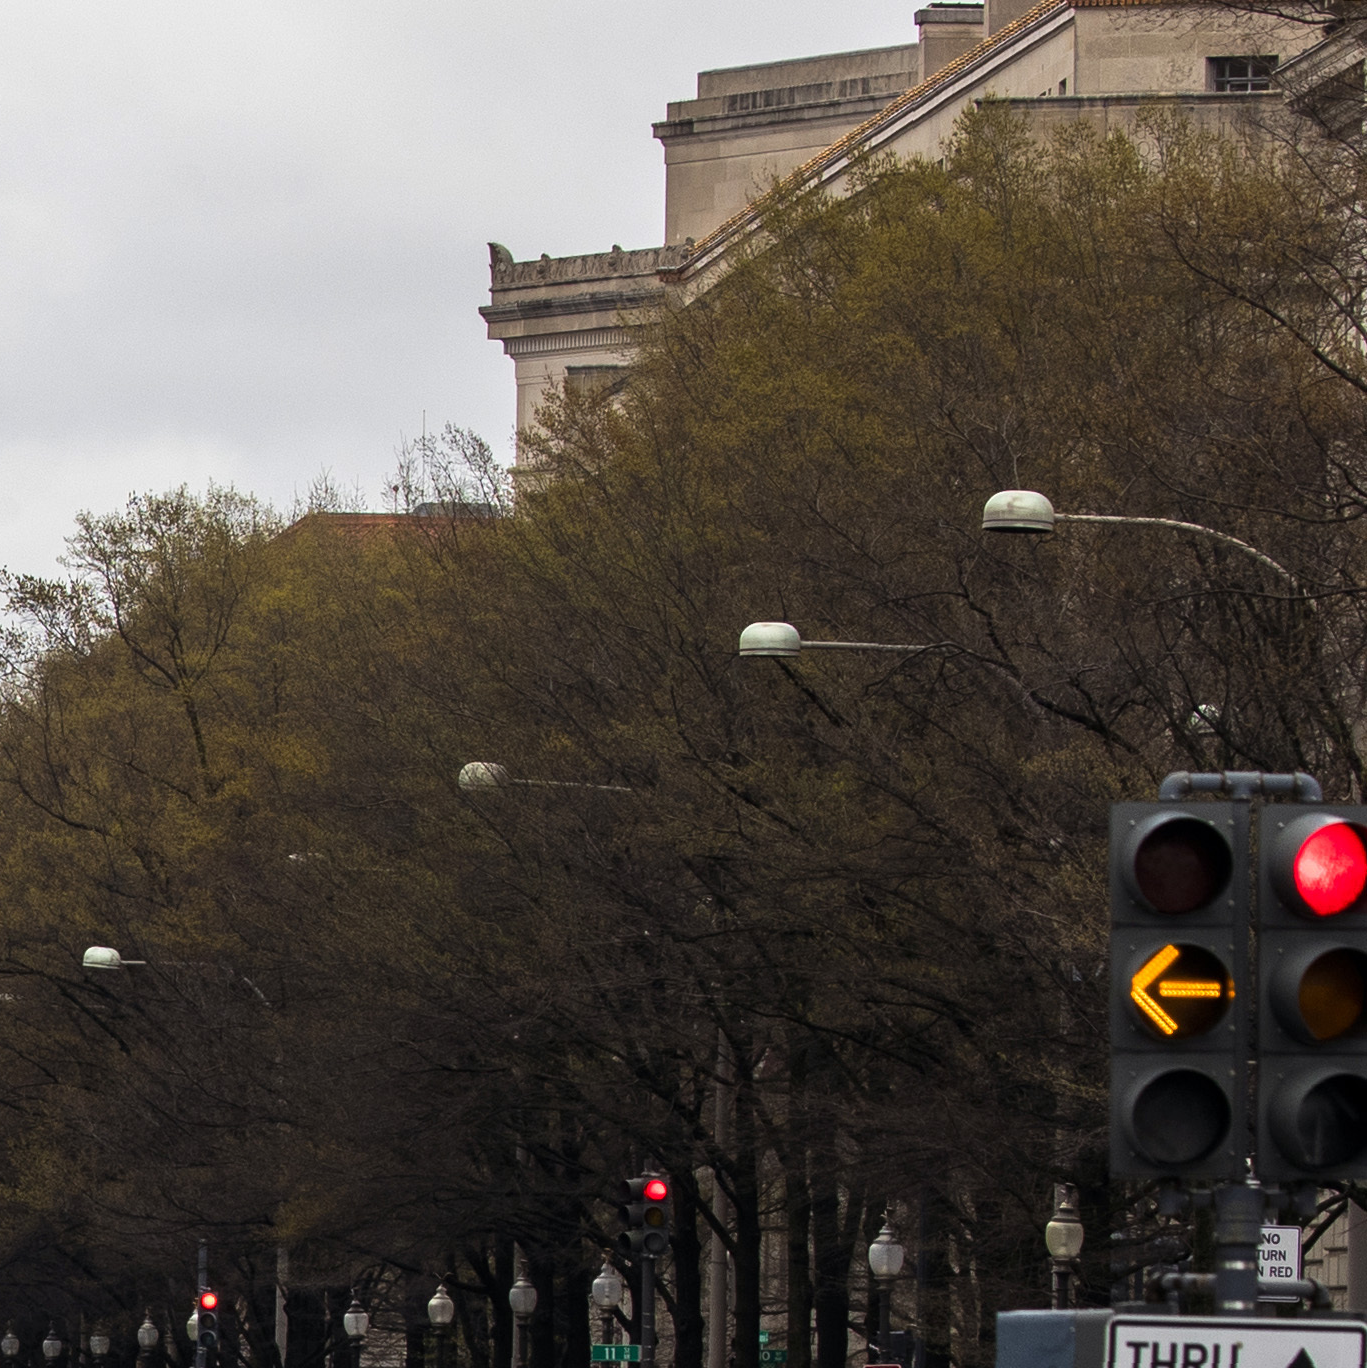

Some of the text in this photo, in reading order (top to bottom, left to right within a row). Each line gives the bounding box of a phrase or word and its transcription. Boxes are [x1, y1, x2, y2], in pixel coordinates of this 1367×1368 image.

[1261, 1232, 1281, 1245] NO
[1257, 1249, 1287, 1261] TURN
[1269, 1266, 1293, 1278] RED
[604, 1347, 616, 1360] 11
